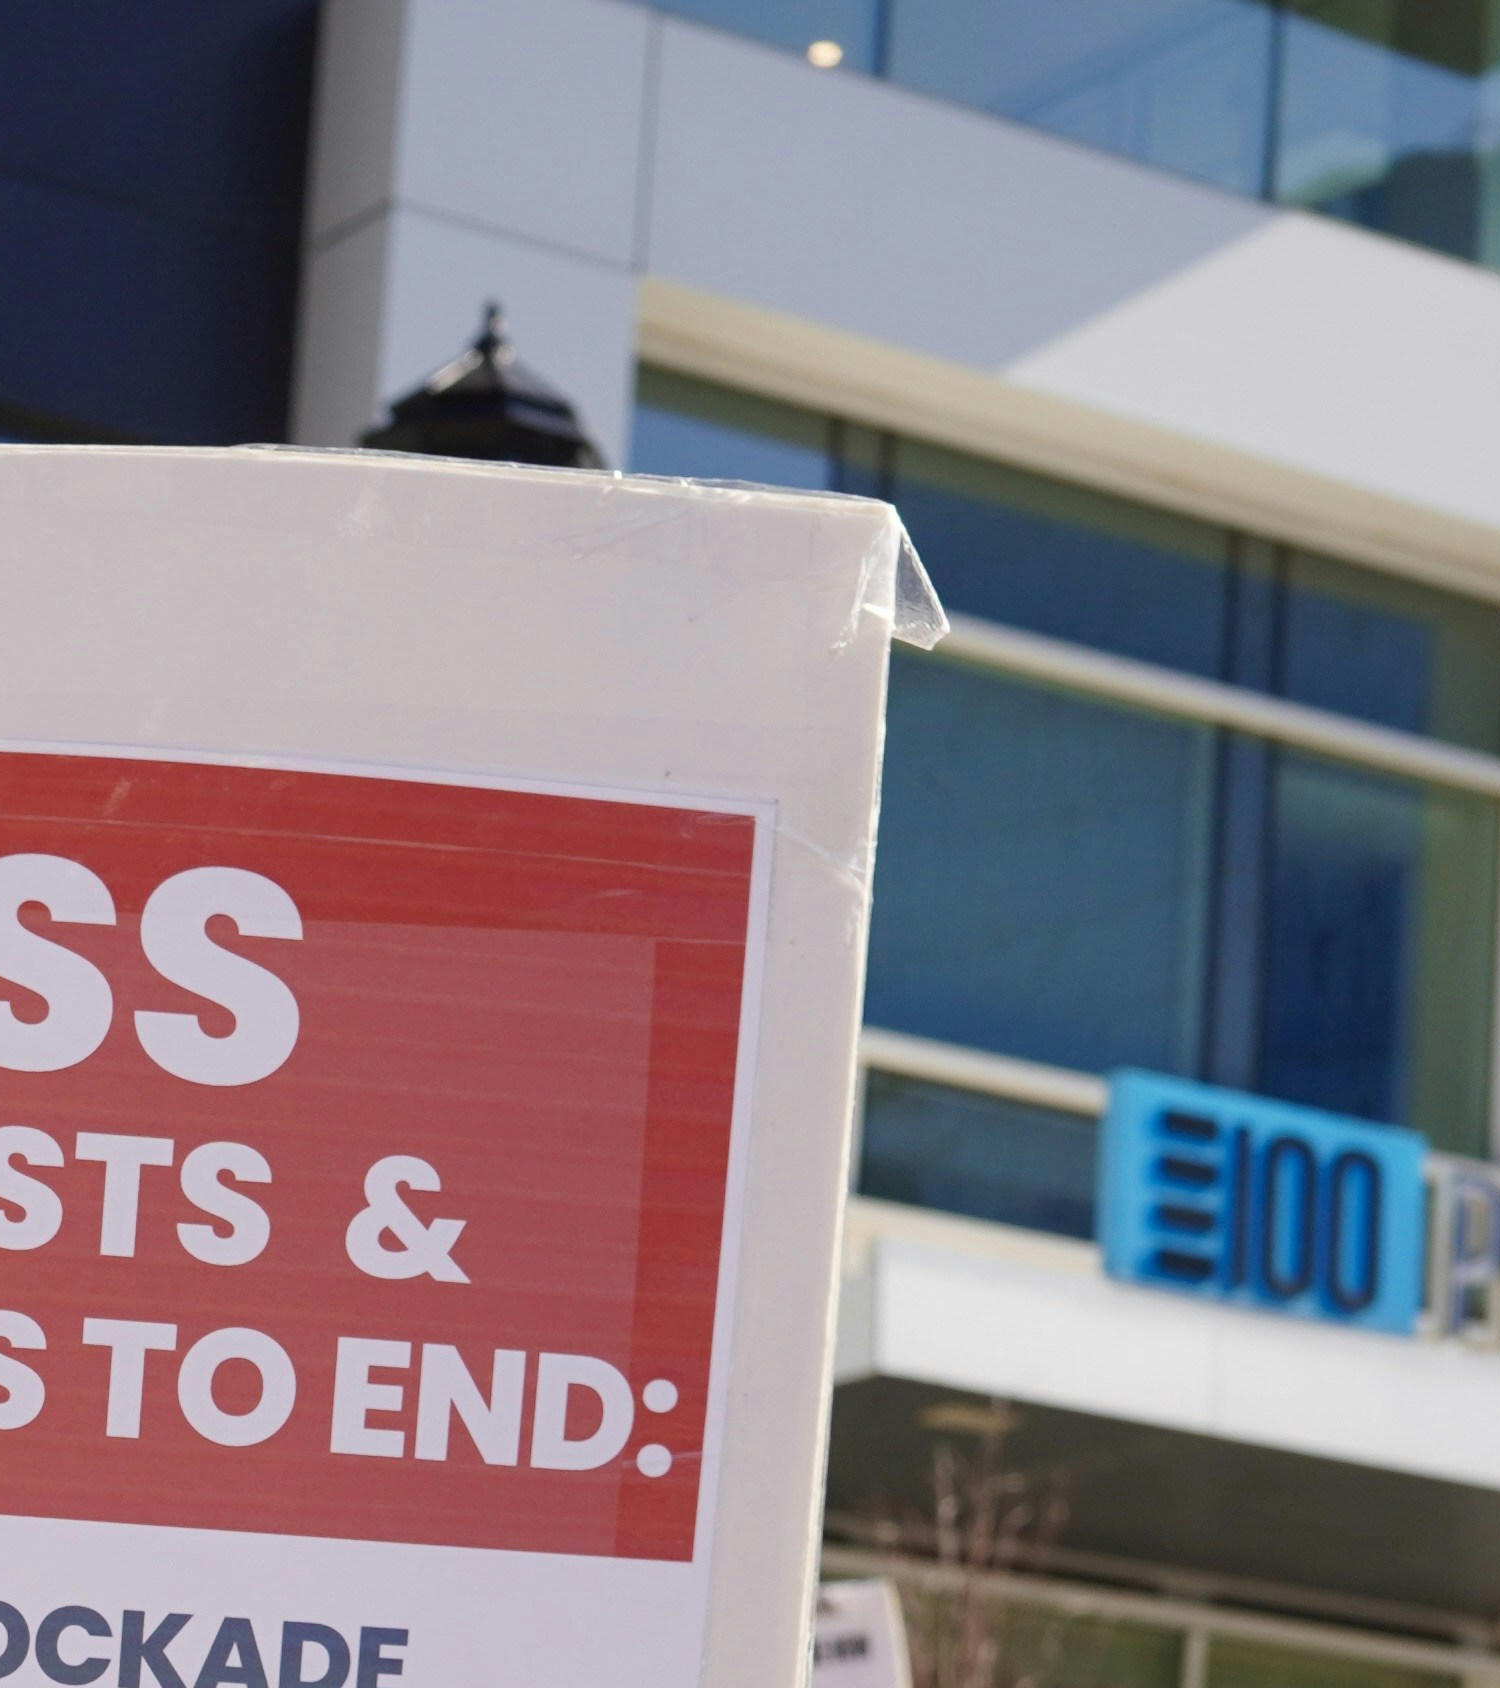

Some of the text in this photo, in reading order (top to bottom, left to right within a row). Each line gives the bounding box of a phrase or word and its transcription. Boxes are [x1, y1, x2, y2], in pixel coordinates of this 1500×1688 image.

[344, 1153, 473, 1285] &
[80, 1316, 298, 1448] TO
[328, 1335, 680, 1479] END:
